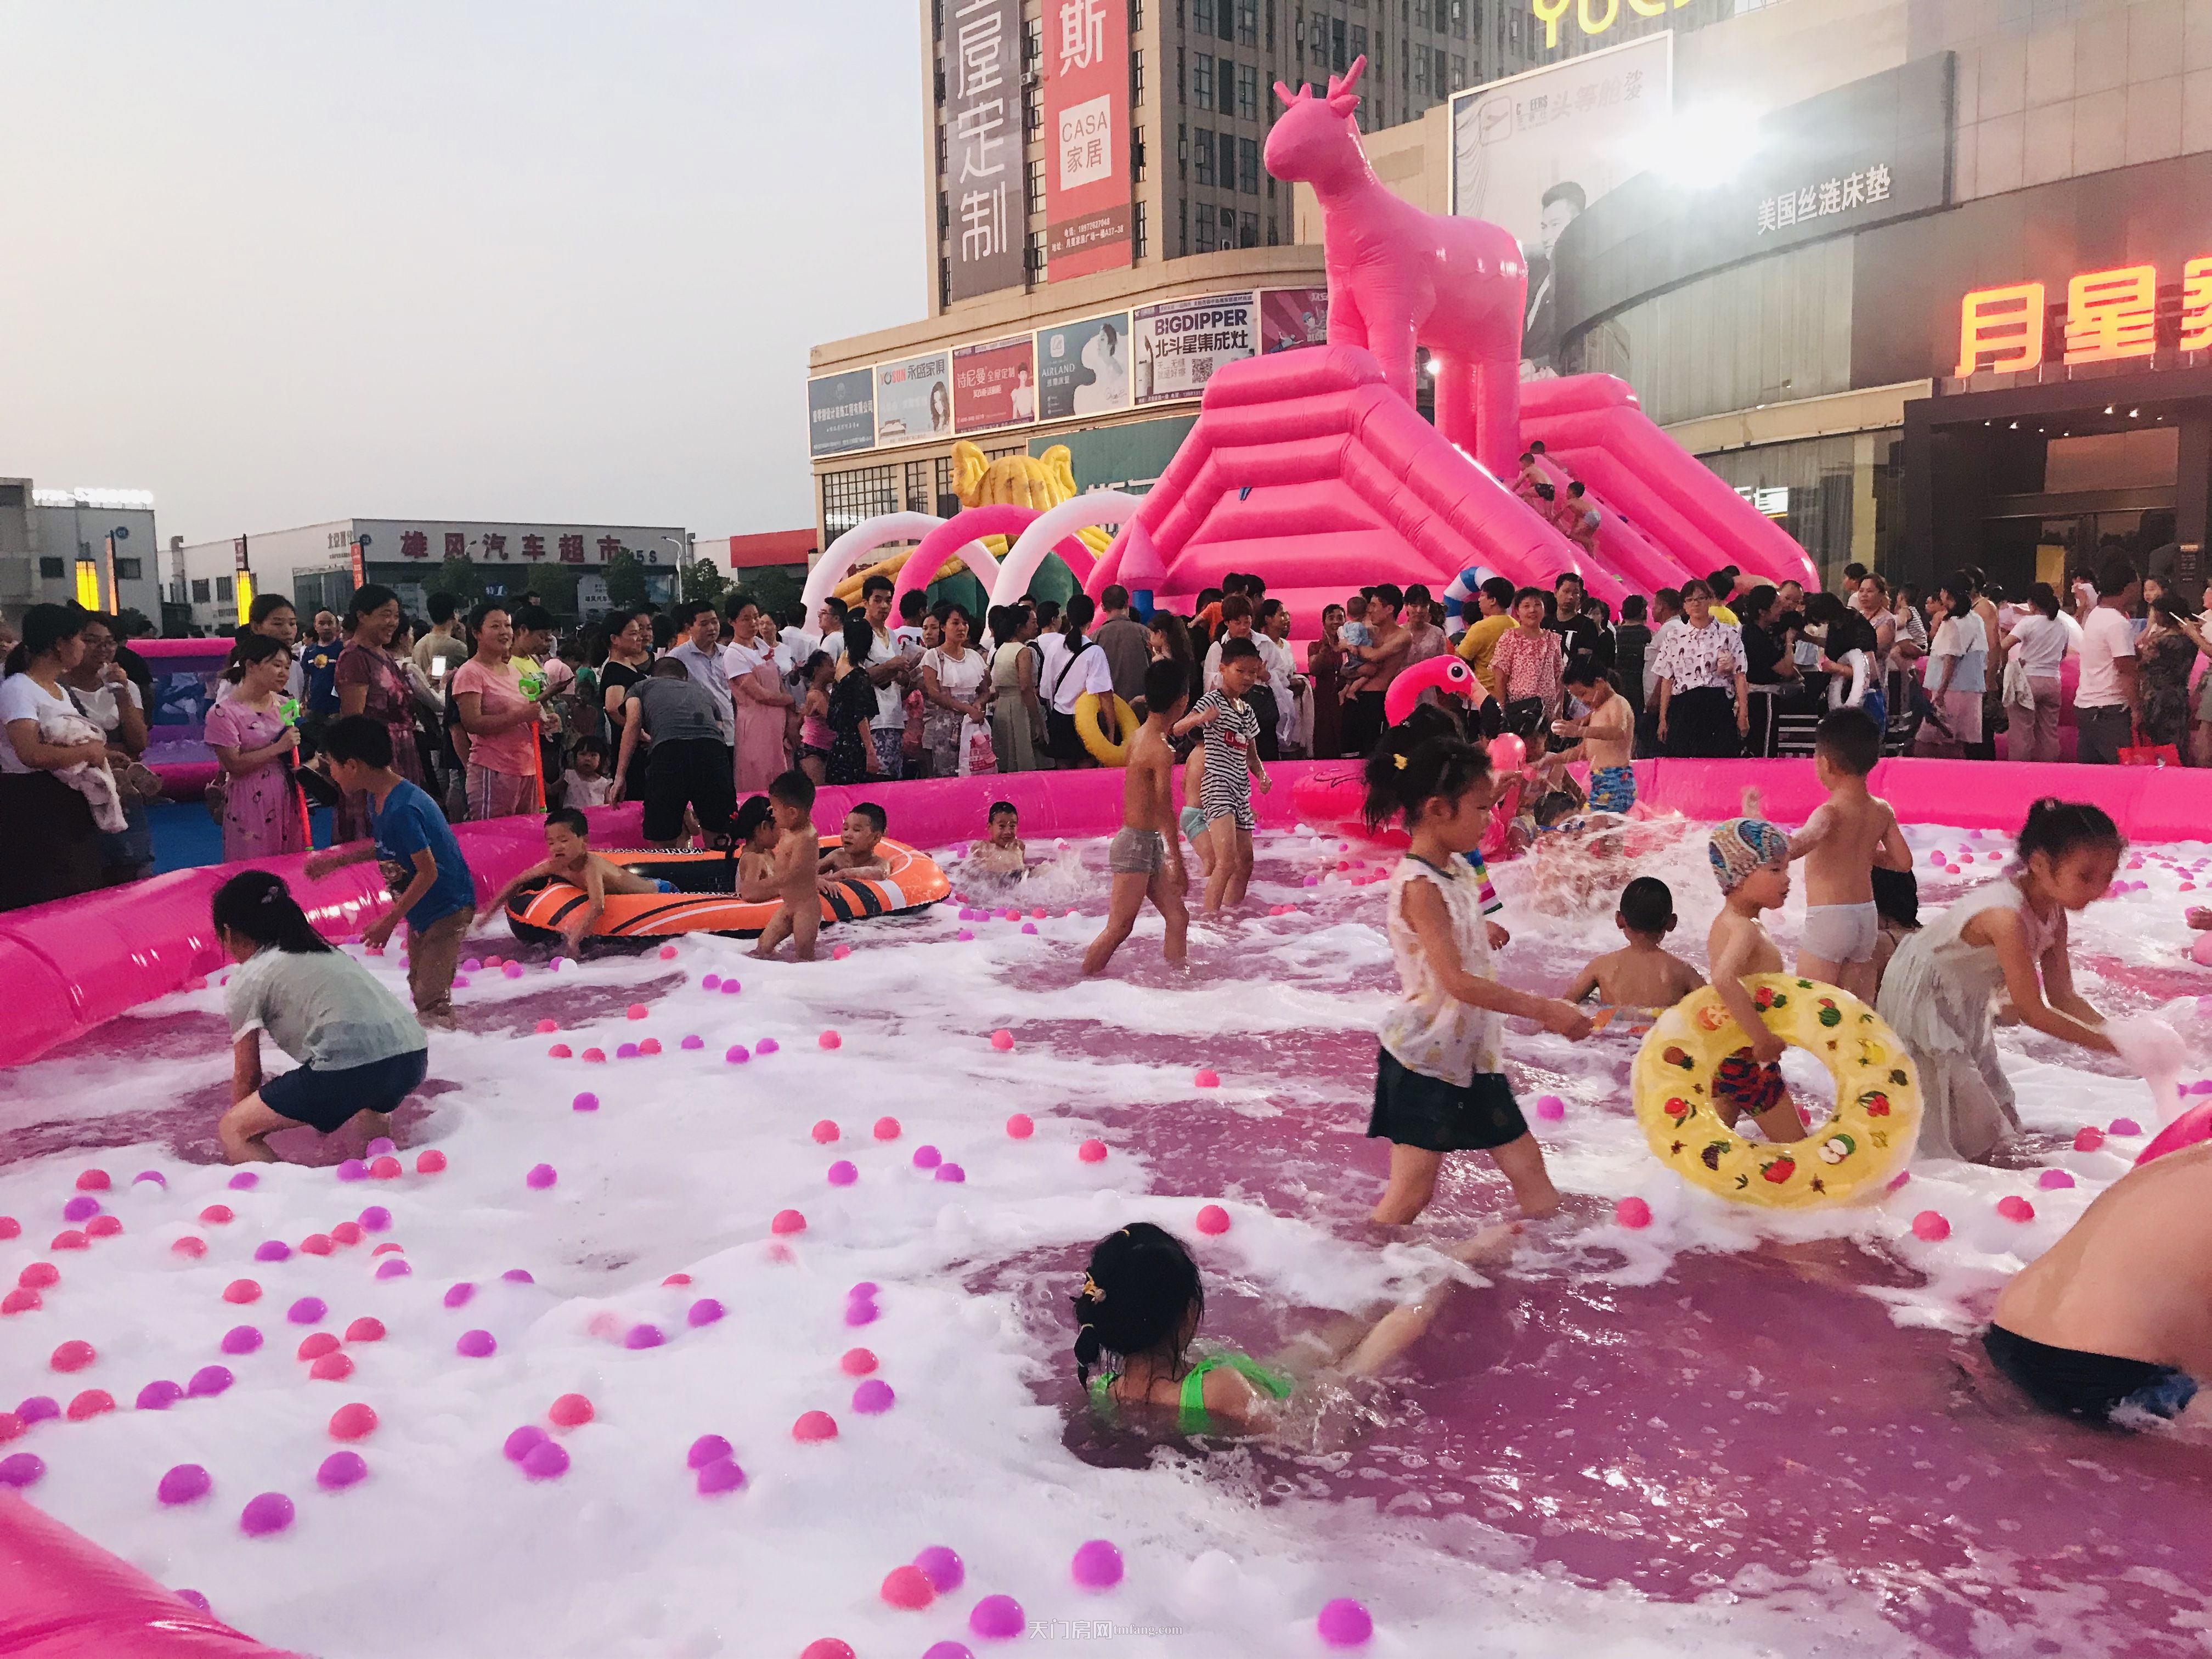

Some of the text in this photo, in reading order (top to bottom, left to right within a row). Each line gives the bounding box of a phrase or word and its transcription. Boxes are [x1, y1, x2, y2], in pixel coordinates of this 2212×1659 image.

[955, 0, 1007, 262] 屋定制
[1062, 111, 1108, 143] CASA
[1067, 138, 1102, 173] 家居
[1757, 163, 1891, 235] 美国丝涟床垫
[1155, 309, 1248, 336] BIGDIPPER
[1155, 330, 1249, 358] 北斗星集成灶
[880, 368, 906, 385] YOSUN
[957, 366, 1015, 388] 诗尼曼 全屋定制
[1042, 363, 1075, 377] AIRLAND
[400, 530, 620, 562] 雄风汽车超市
